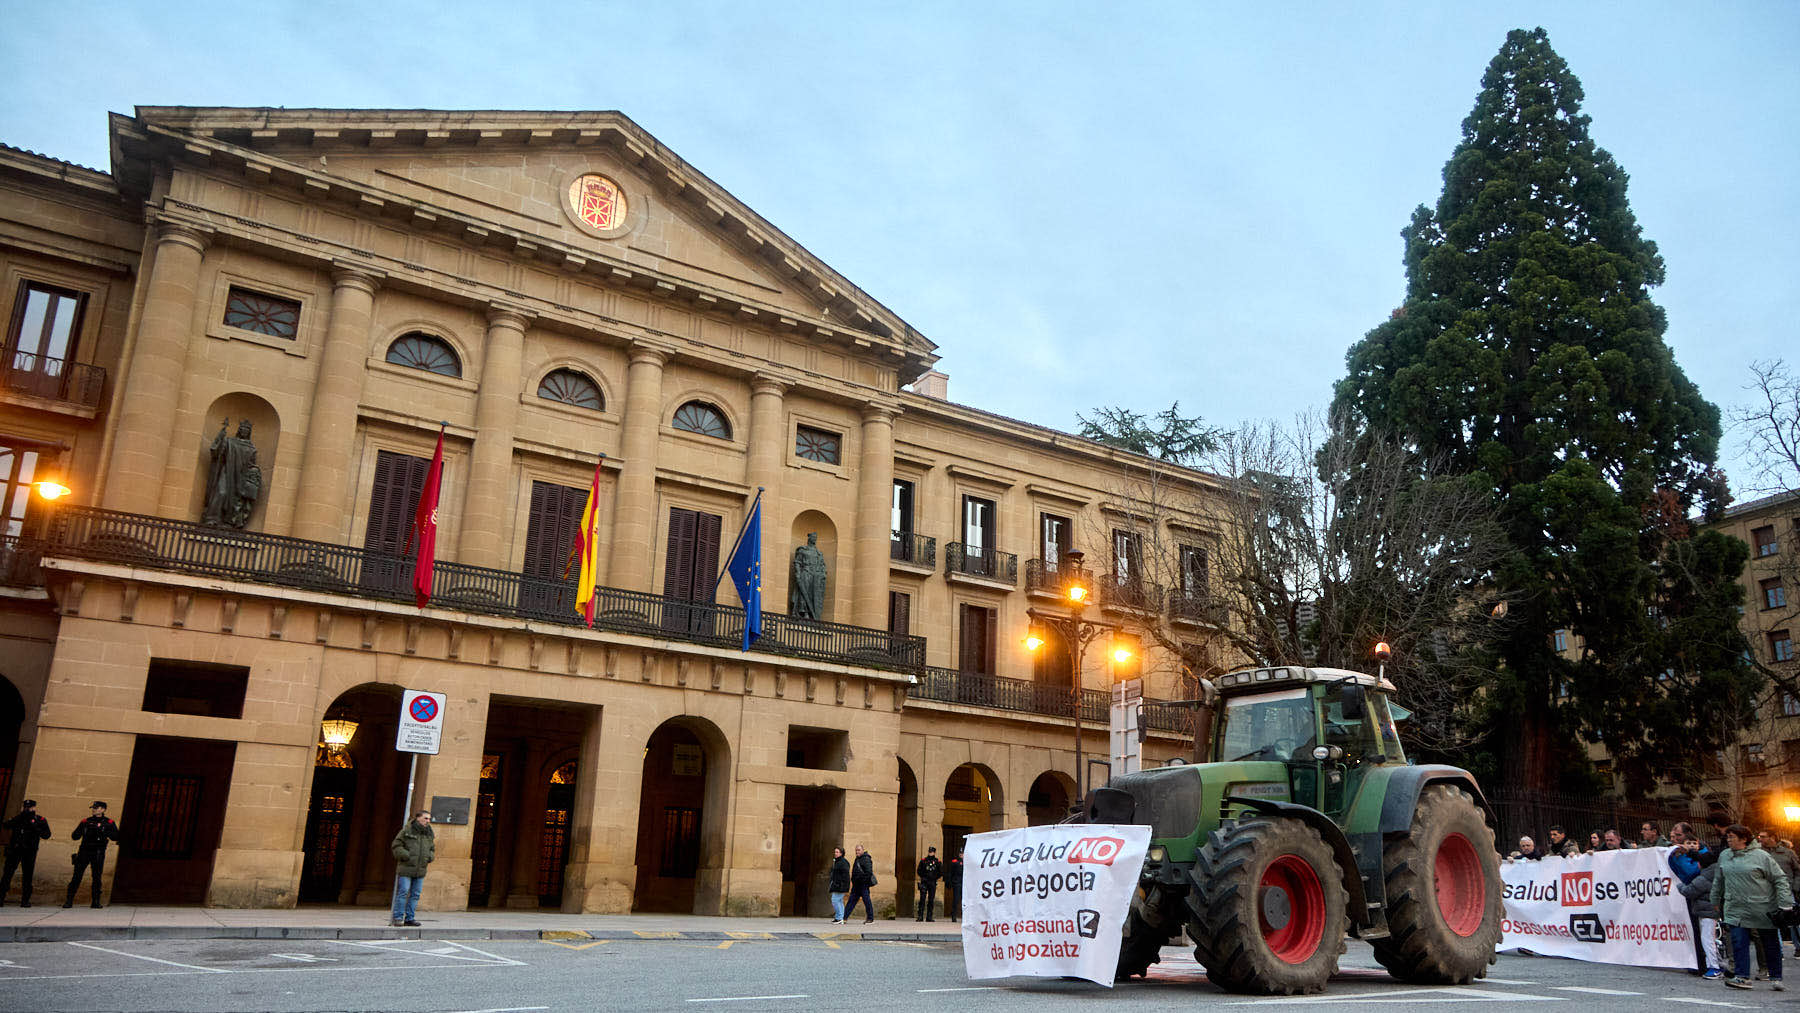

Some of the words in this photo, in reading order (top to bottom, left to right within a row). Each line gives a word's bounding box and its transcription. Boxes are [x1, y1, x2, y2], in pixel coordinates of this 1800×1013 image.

[980, 848, 1003, 868] Tu
[1007, 840, 1072, 865] salud
[1070, 840, 1117, 861] NO
[981, 878, 1005, 899] se
[1011, 865, 1096, 899] negocia
[1502, 880, 1558, 901] salud
[1564, 877, 1592, 903] NO
[1595, 882, 1619, 900] se
[980, 921, 1010, 938] Zure
[1501, 919, 1571, 937] osasuna
[1573, 919, 1603, 940] EZ
[1605, 919, 1621, 940] da
[991, 943, 1004, 960] da
